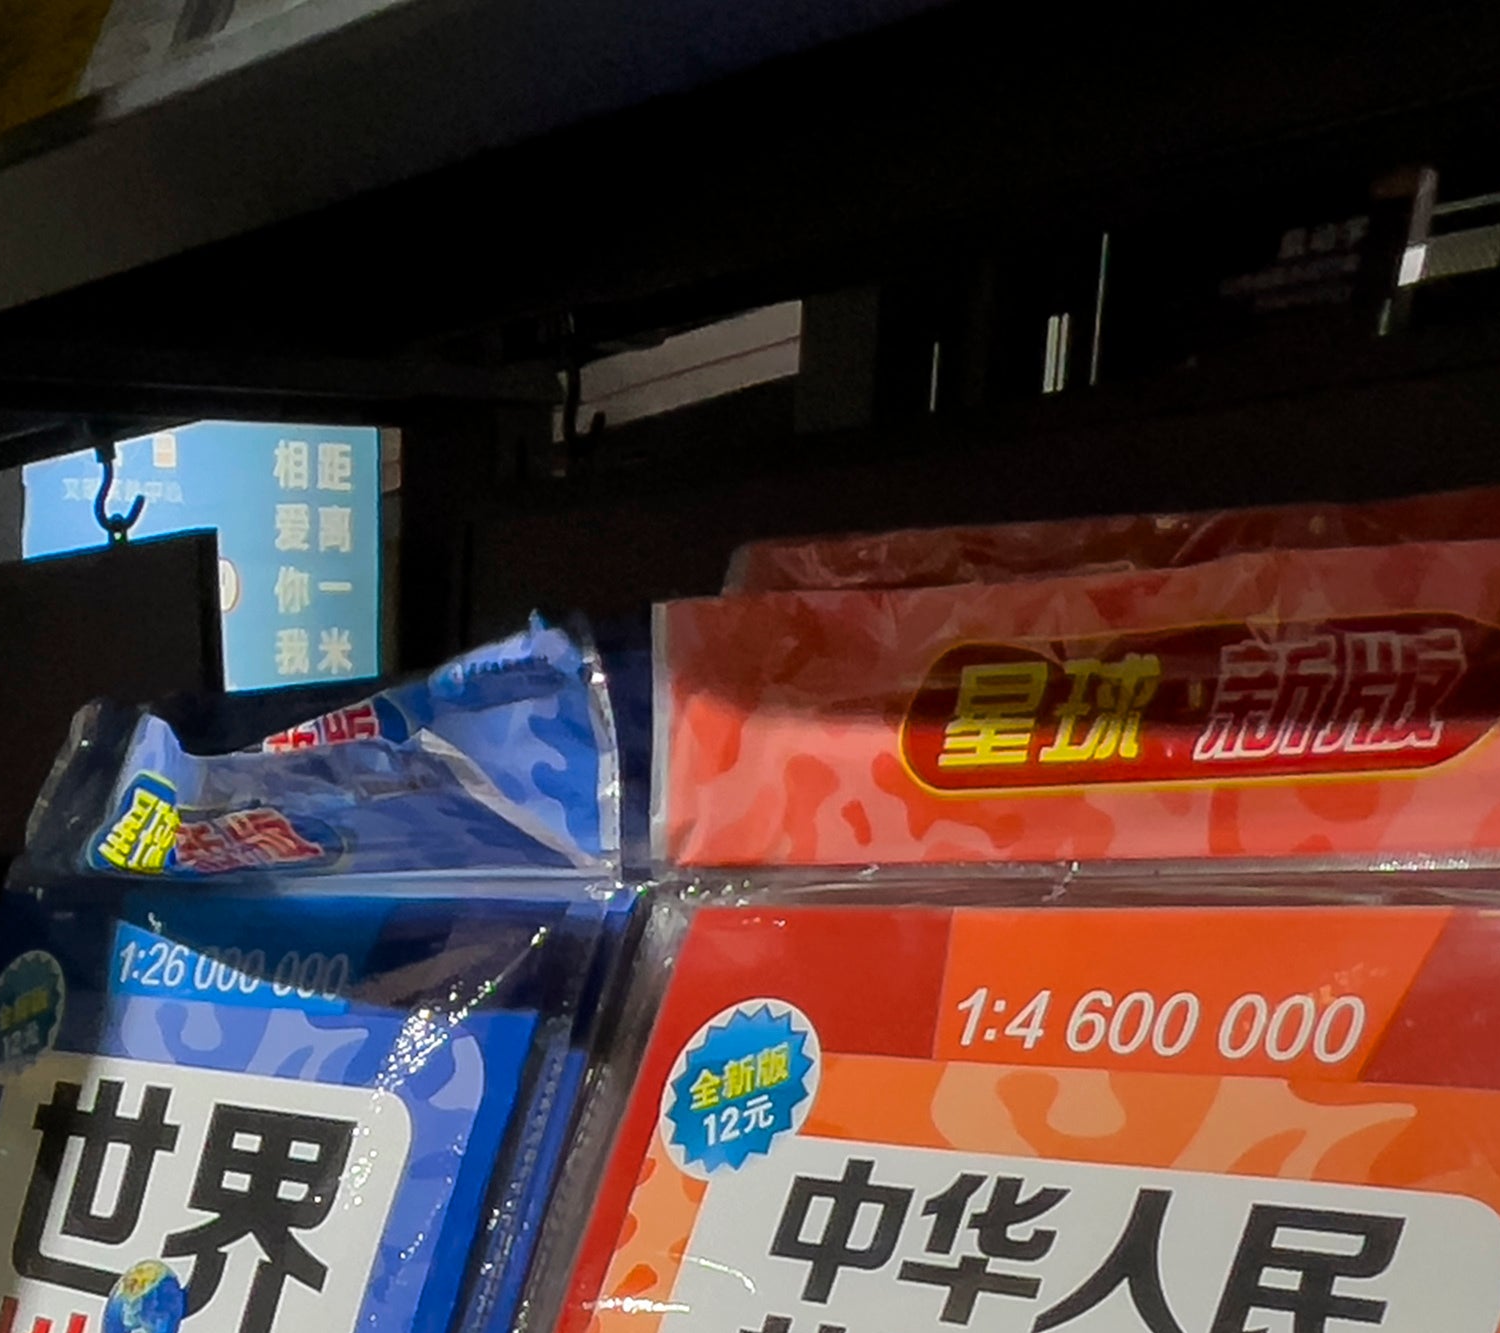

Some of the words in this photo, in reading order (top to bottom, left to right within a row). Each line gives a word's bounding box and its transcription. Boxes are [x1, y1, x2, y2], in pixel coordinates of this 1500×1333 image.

[937, 653, 1161, 770] 星球
[1193, 631, 1469, 761] 新版
[118, 943, 185, 990] 1:26
[195, 944, 260, 996] 000
[272, 951, 350, 1002] 000
[953, 985, 1045, 1053] 1:4
[1065, 989, 1201, 1058] 600
[1219, 994, 1365, 1064] 000
[689, 1042, 791, 1111] 全新版
[703, 1094, 775, 1147] 12元
